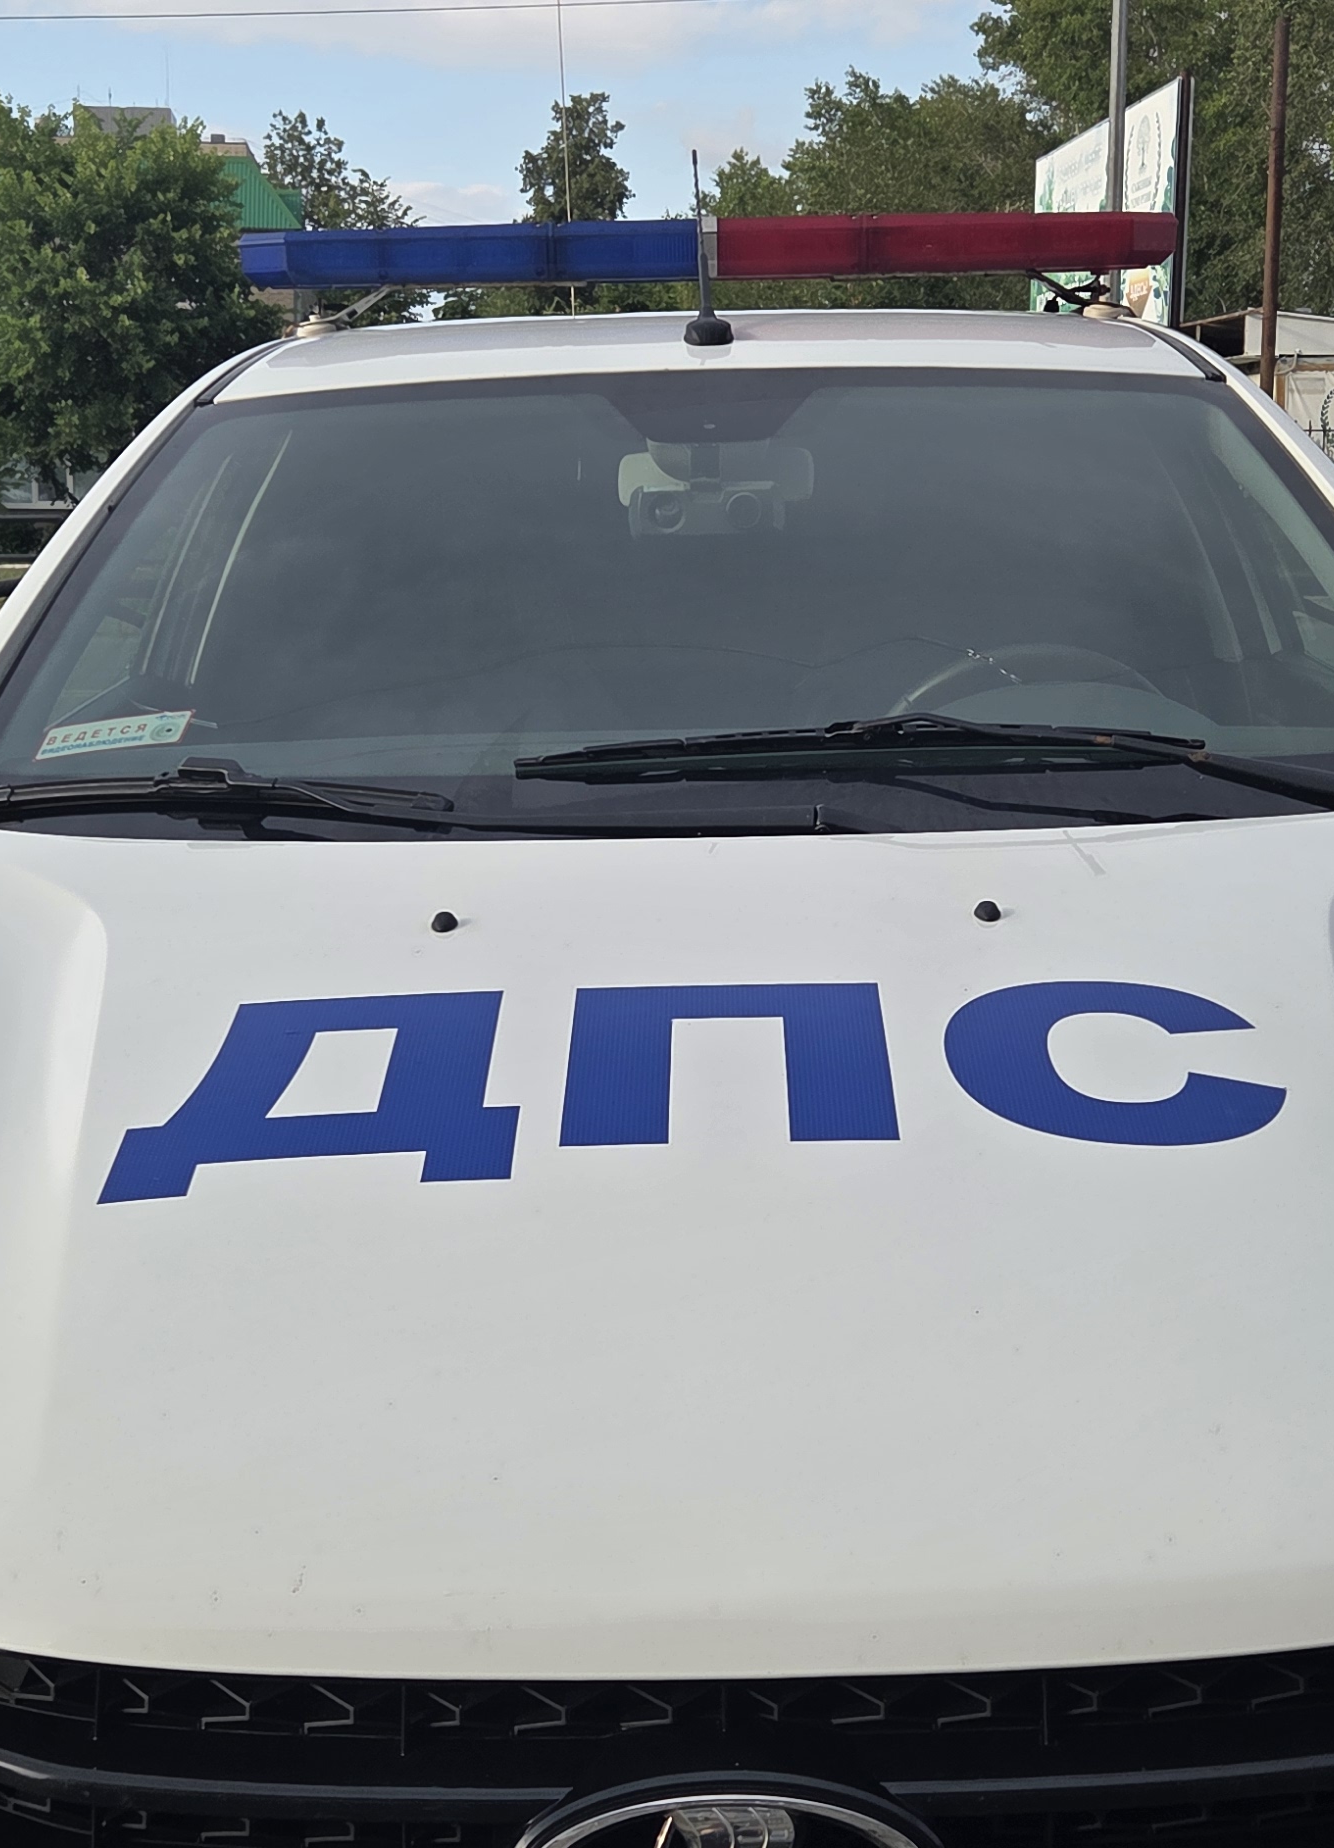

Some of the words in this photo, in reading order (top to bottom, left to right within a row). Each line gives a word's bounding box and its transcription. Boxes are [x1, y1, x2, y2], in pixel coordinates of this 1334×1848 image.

[41, 735, 145, 755] ВИДЕОНАБЛЮДЕНИЕ
[46, 723, 148, 746] ВЕДЕТСЯ
[96, 980, 1288, 1204] ДПС
